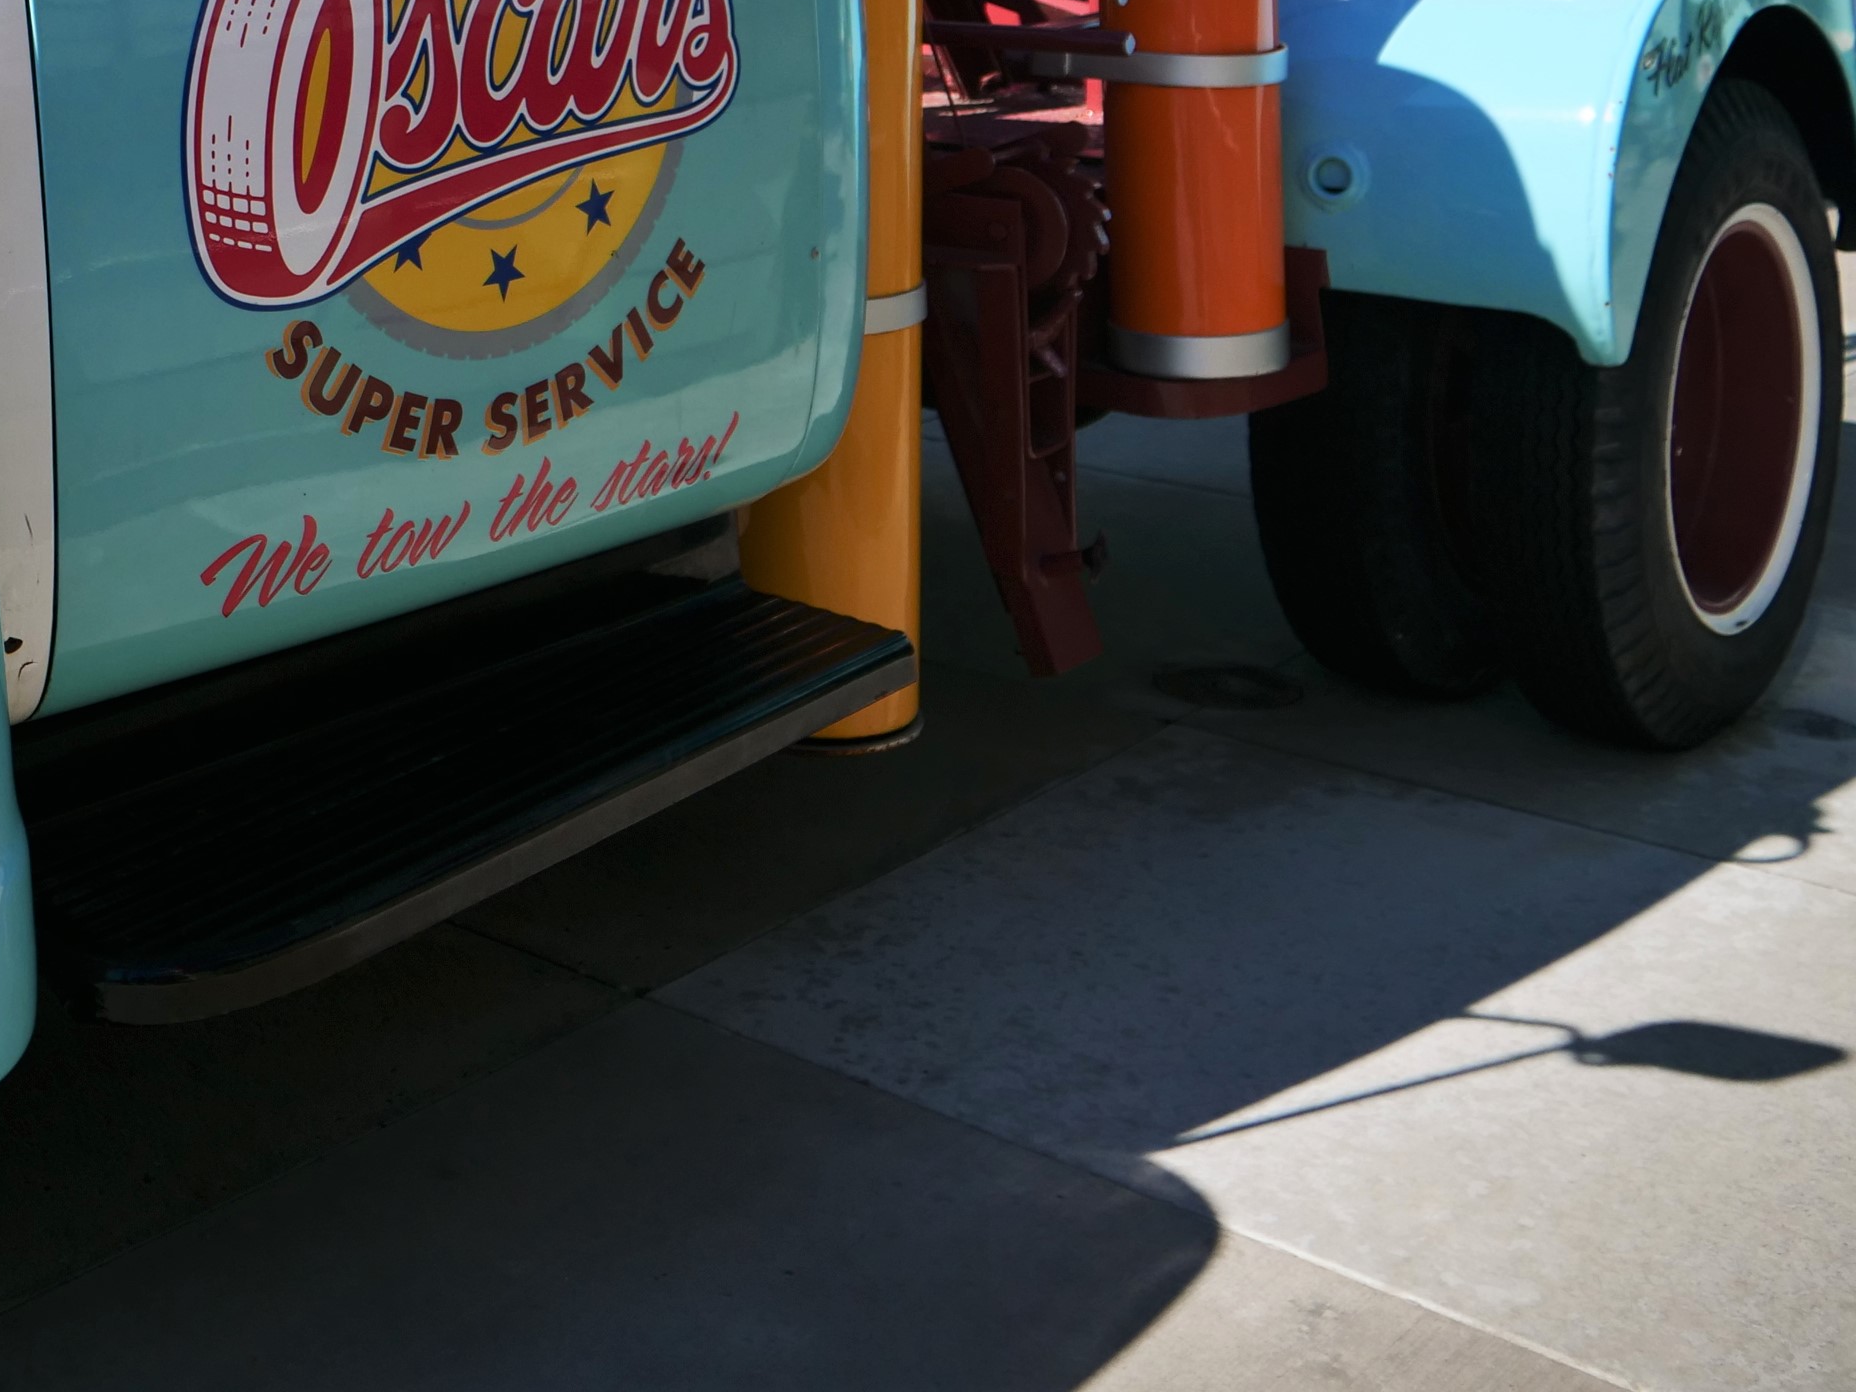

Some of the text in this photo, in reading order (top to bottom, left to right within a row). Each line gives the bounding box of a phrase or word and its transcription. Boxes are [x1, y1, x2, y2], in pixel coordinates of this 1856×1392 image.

[266, 237, 706, 459] SUPER SERVICE
[200, 411, 740, 618] We tow the stars!
